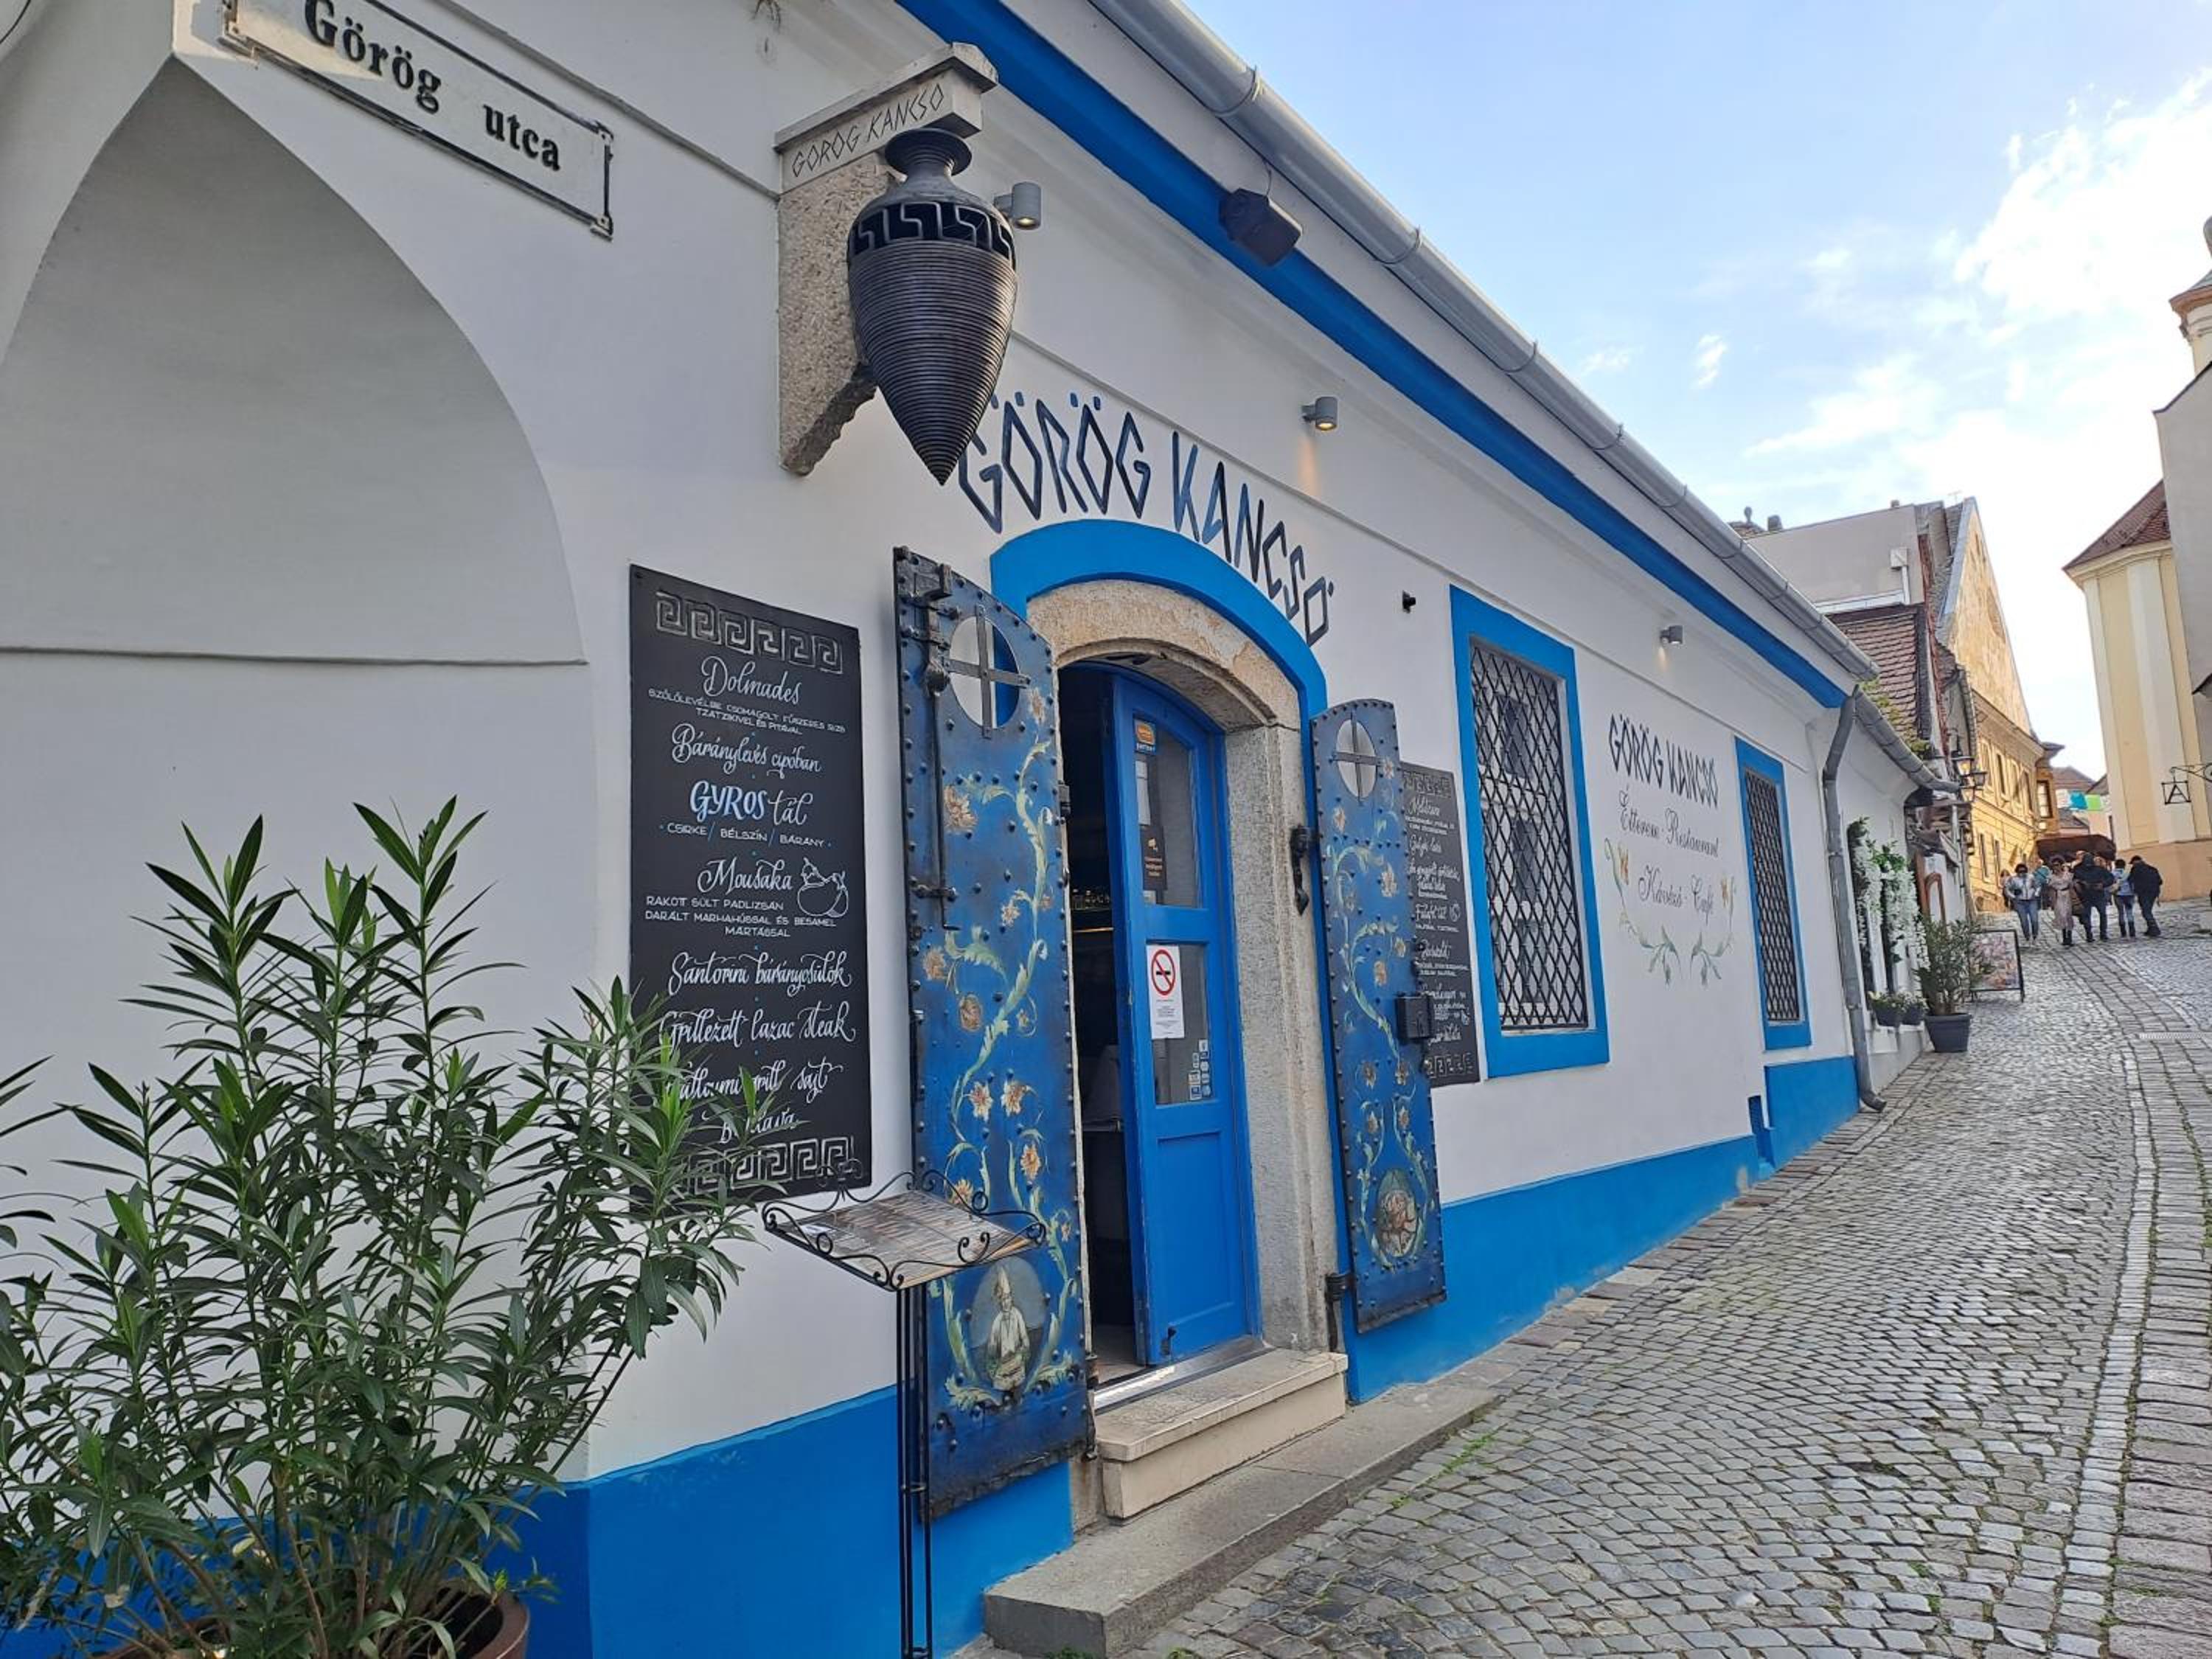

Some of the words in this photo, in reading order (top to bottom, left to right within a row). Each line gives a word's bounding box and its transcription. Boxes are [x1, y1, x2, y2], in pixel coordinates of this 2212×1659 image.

[304, 0, 442, 114] Görög
[483, 105, 560, 172] utca
[958, 391, 1151, 535] GÖRÖG
[701, 655, 802, 705] Dolmades
[767, 745, 823, 779] cipóban
[1609, 714, 1664, 790] GÖRÖG
[689, 779, 768, 823] GYROS
[768, 790, 813, 826] tál
[1665, 807, 1719, 858] Restaurant
[698, 856, 793, 895] Mousaka
[646, 896, 688, 906] RAKOTT
[694, 911, 772, 925] MARHAHÚSSAL
[776, 915, 790, 925] ÉS
[668, 950, 750, 996] Santorini
[751, 1008, 796, 1042] lazac
[797, 1000, 856, 1043] steak
[790, 1056, 844, 1104] sajt
